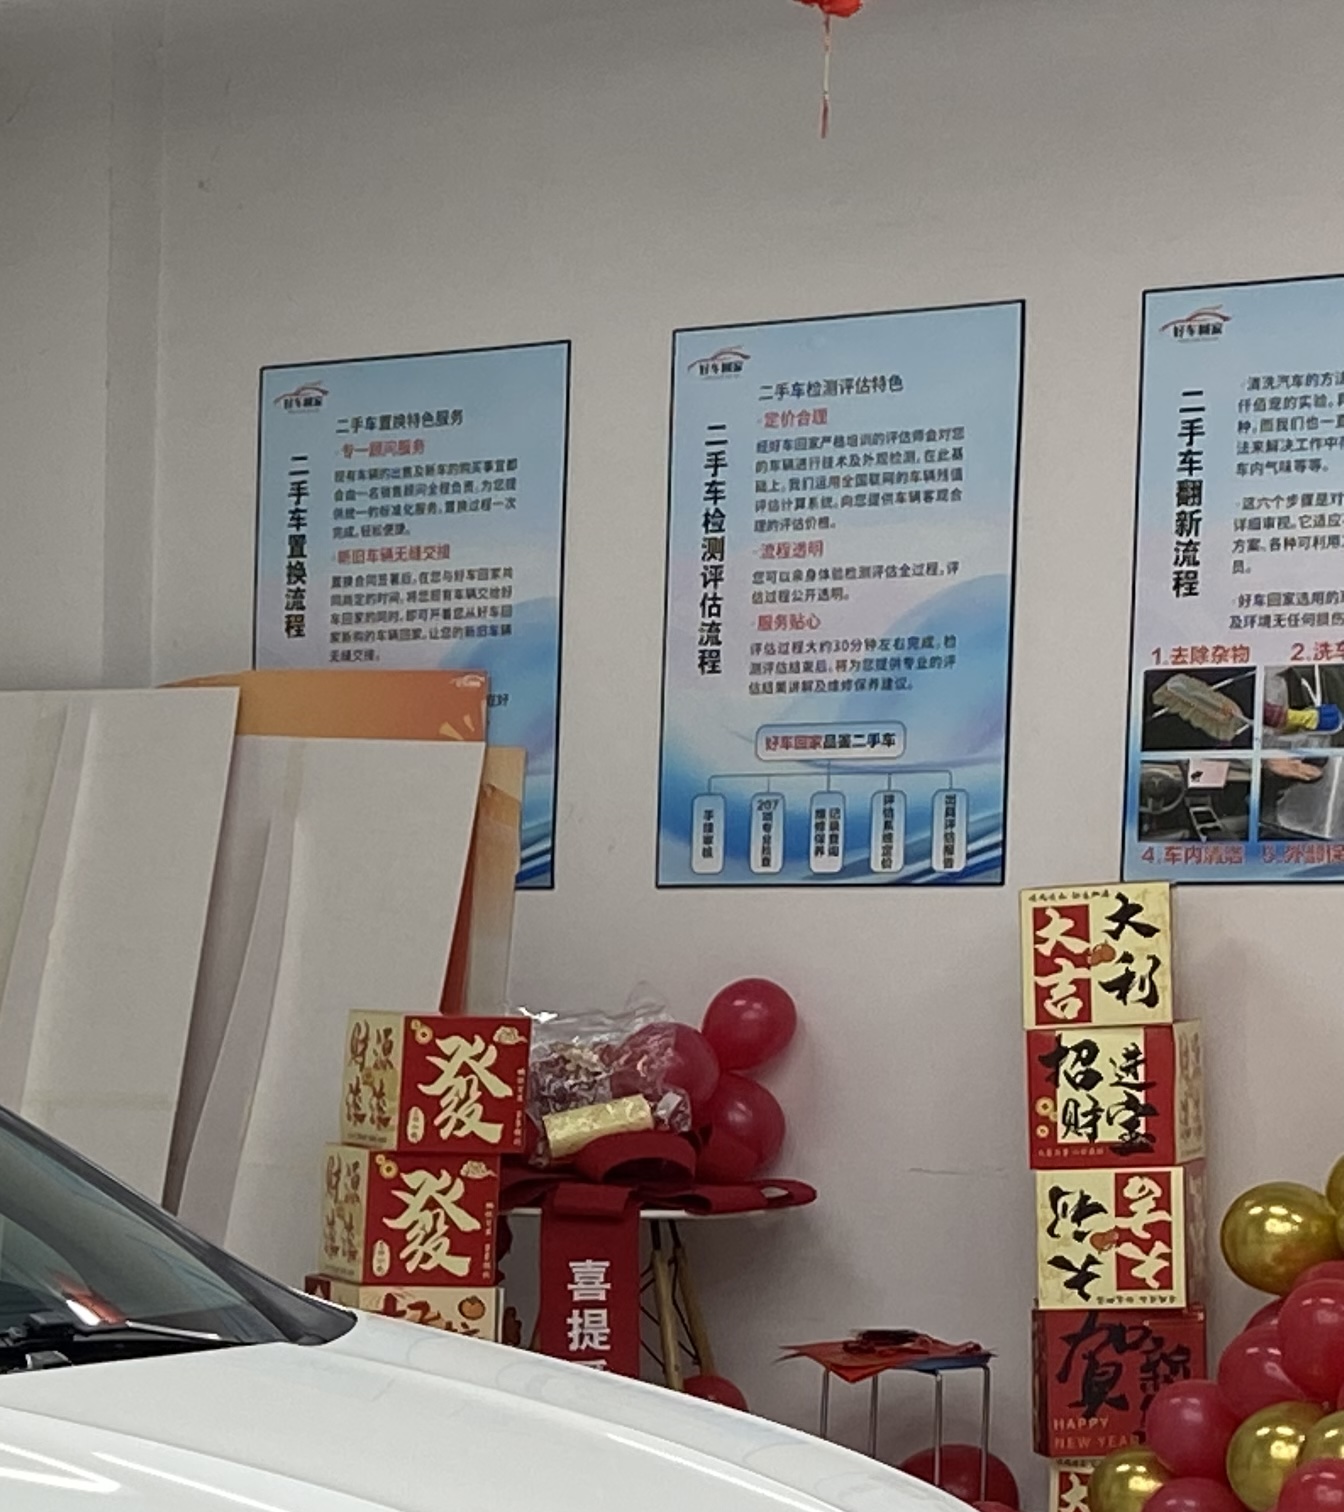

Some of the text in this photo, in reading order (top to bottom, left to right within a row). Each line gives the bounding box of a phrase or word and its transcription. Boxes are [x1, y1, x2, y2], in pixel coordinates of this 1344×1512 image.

[759, 375, 904, 401] 二手车检测评估特色
[336, 409, 463, 433] 二手车置换特色服务
[764, 407, 828, 428] 定价合理
[1172, 390, 1205, 598] 二手车翻新流程
[1233, 513, 1344, 532] 详细审视。它适应
[285, 455, 310, 638] 二手车置换流程
[337, 544, 450, 565] 新旧车辆无缝交接
[698, 424, 728, 675] 二手车检测评估流程
[760, 540, 824, 560] 流程透明
[1232, 535, 1344, 553] 方案、各种可利用
[757, 613, 822, 632] 服务贴心
[1152, 644, 1250, 665] 1.去除杂物
[566, 1259, 611, 1371] 喜提
[1053, 1416, 1109, 1430] HAPPY
[1055, 1436, 1091, 1449] NEW
